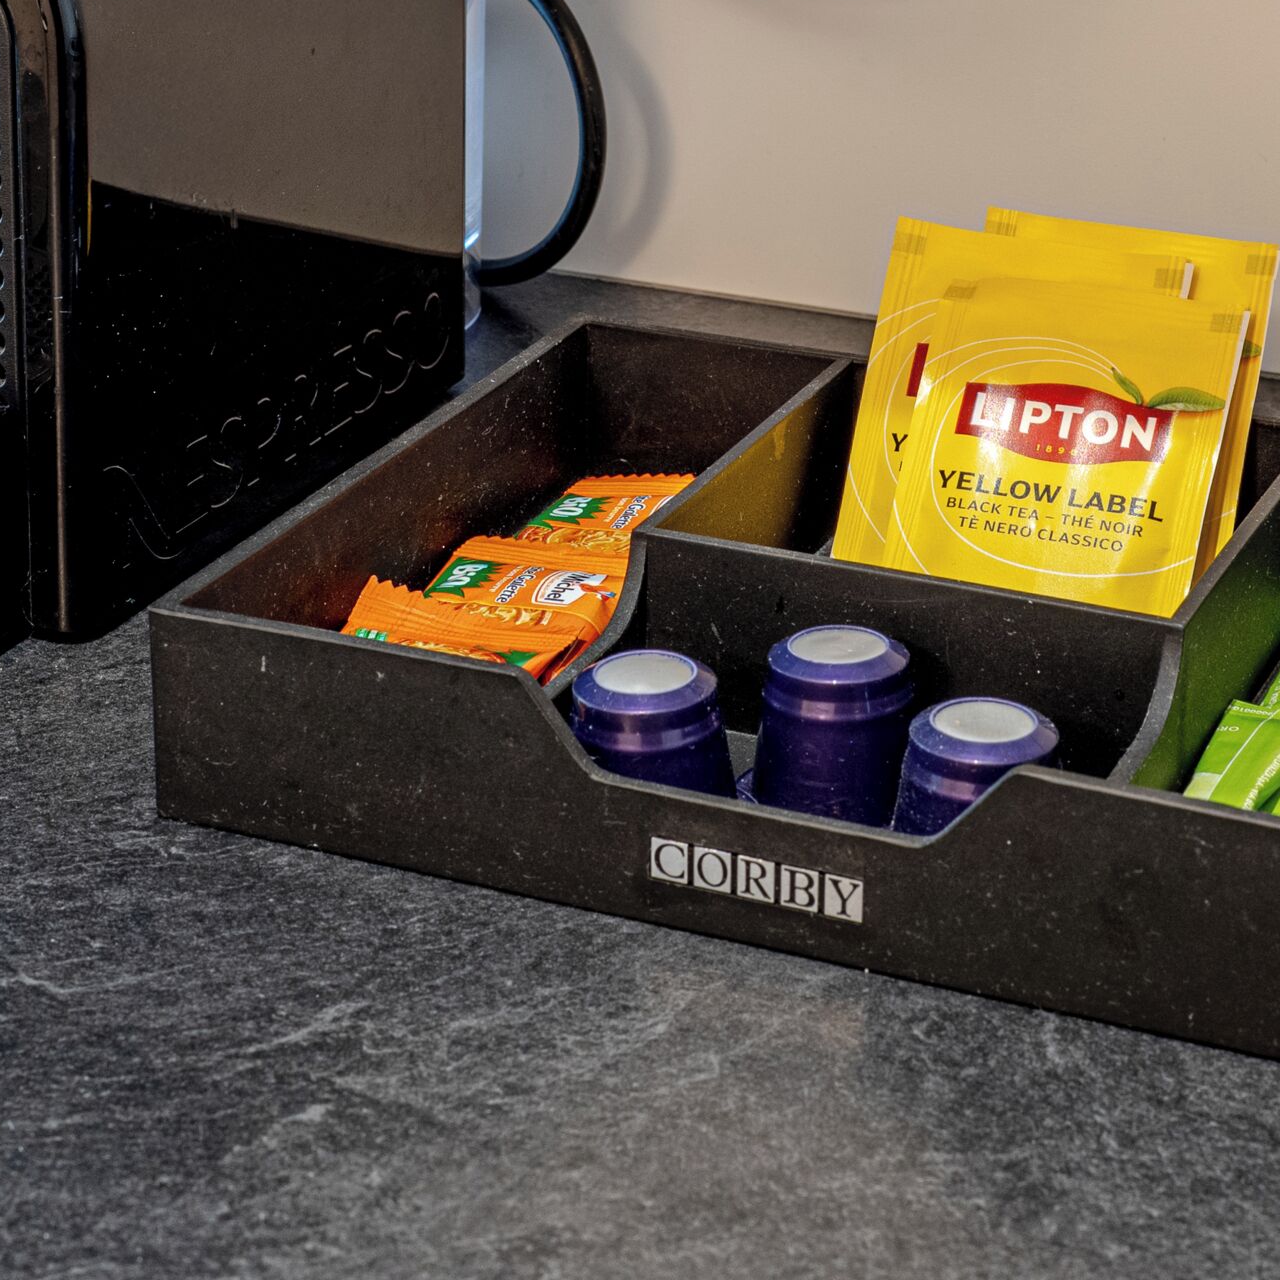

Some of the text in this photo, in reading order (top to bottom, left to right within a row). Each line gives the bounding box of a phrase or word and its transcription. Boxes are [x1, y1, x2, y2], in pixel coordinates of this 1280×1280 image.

[970, 391, 1157, 451] LIPTON
[938, 469, 1164, 522] YELLOW LABEL
[946, 496, 1001, 515] BLACK
[1007, 505, 1039, 521] TEA
[1061, 513, 1093, 529] THÉ
[1100, 521, 1144, 538] NOIR
[959, 515, 1124, 552] TÈ NERO CLASSICO
[496, 575, 535, 602] Galette
[544, 574, 590, 601] Michel
[654, 843, 860, 918] CORBY
